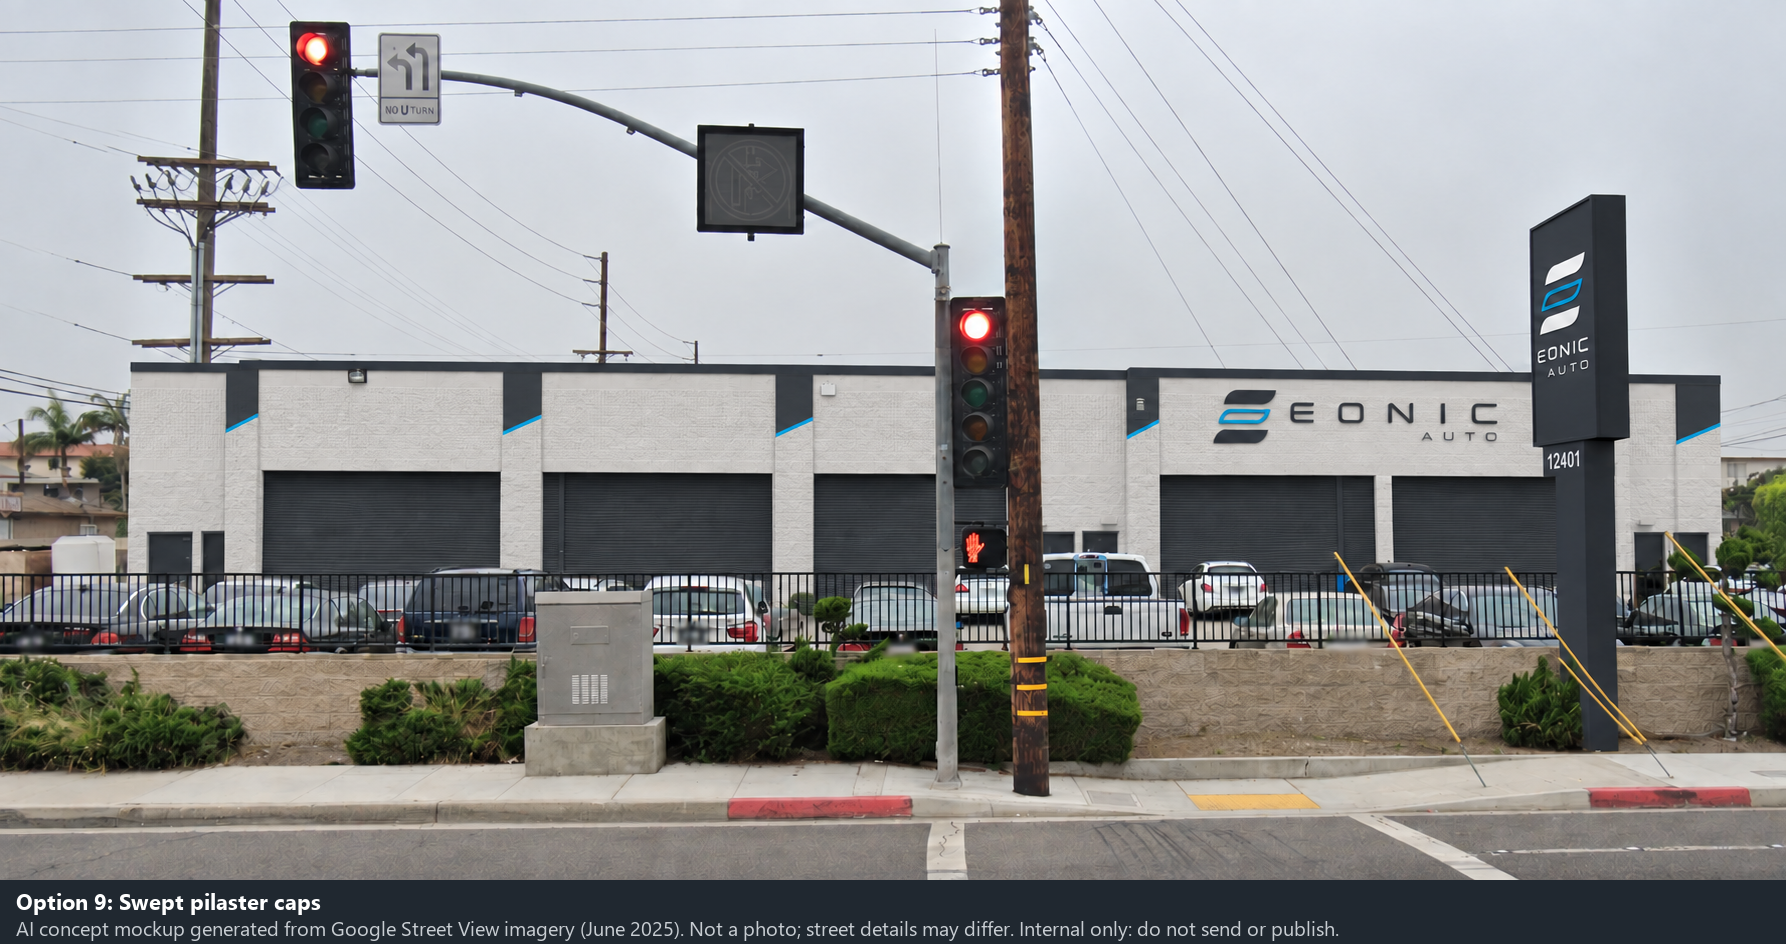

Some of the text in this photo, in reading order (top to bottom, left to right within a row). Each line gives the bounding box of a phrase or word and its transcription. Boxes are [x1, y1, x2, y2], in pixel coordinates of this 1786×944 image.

[385, 104, 434, 116] NO U TURN
[1537, 336, 1589, 364] EONIC
[1547, 359, 1589, 378] AUTO
[1289, 402, 1498, 425] EONIC
[1421, 431, 1498, 442] AUTO
[1547, 449, 1580, 470] 12401
